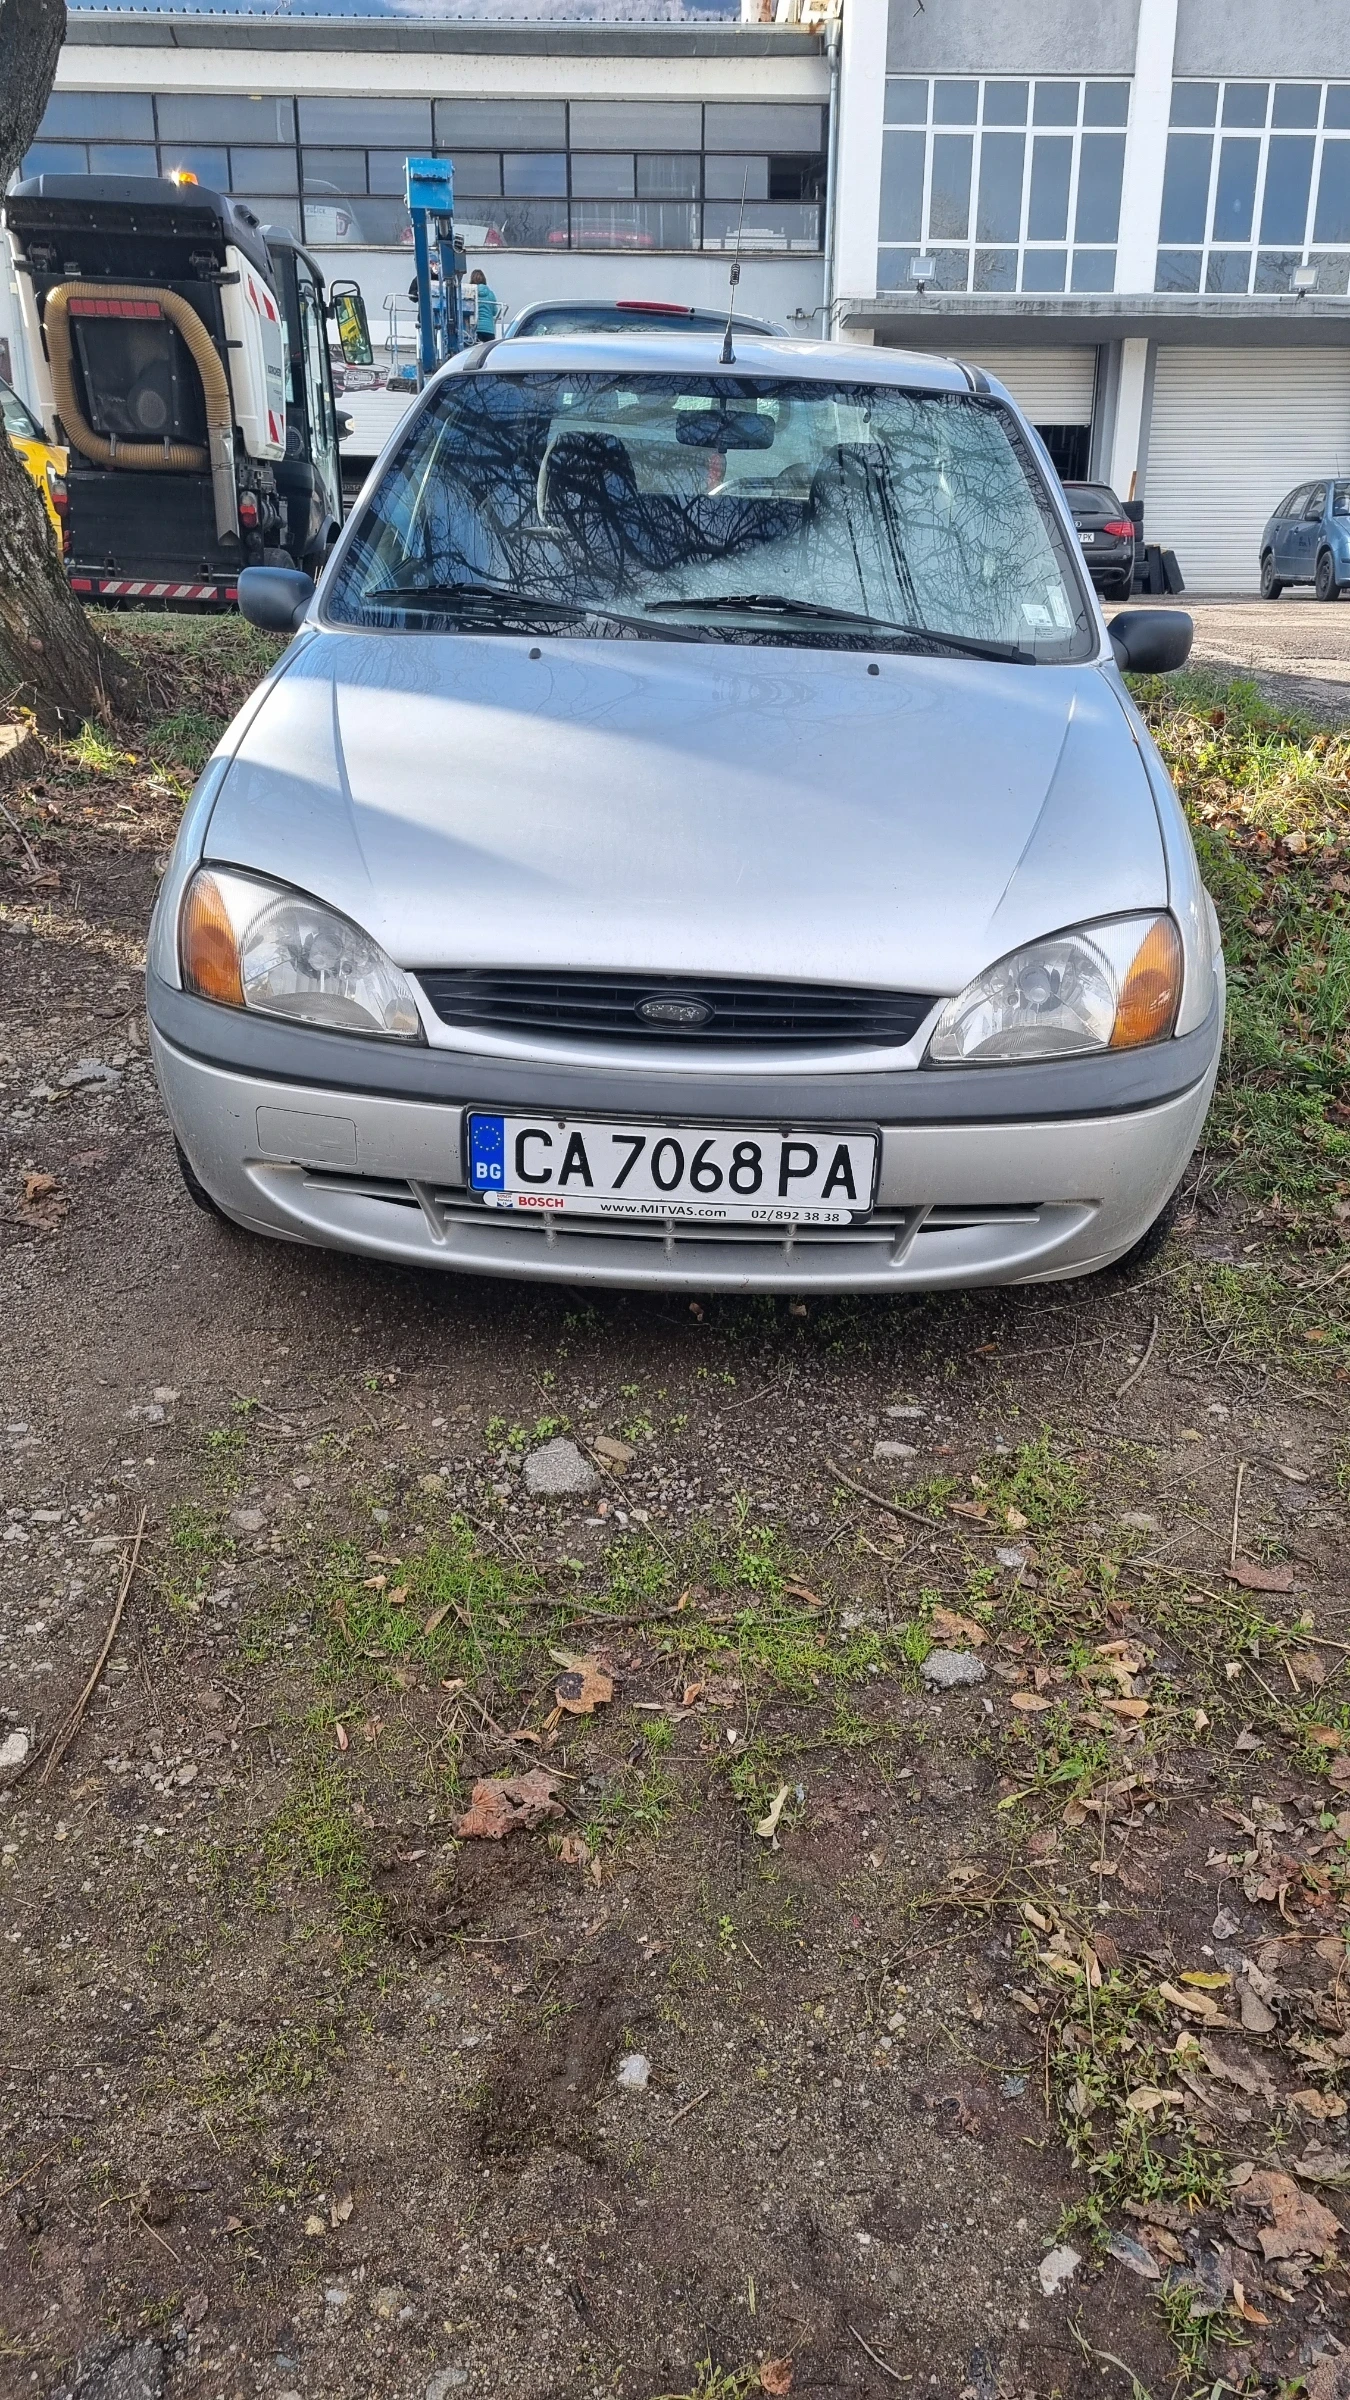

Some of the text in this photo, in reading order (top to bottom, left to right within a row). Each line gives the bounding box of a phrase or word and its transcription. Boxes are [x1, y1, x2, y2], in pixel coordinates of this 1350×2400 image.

[476, 1162, 502, 1180] BG
[515, 1128, 858, 1200] CA 7068 PA
[518, 1196, 565, 1208] BOSCH
[600, 1203, 727, 1218] www.MITVAS.com
[751, 1209, 840, 1222] 02/892 38 38
